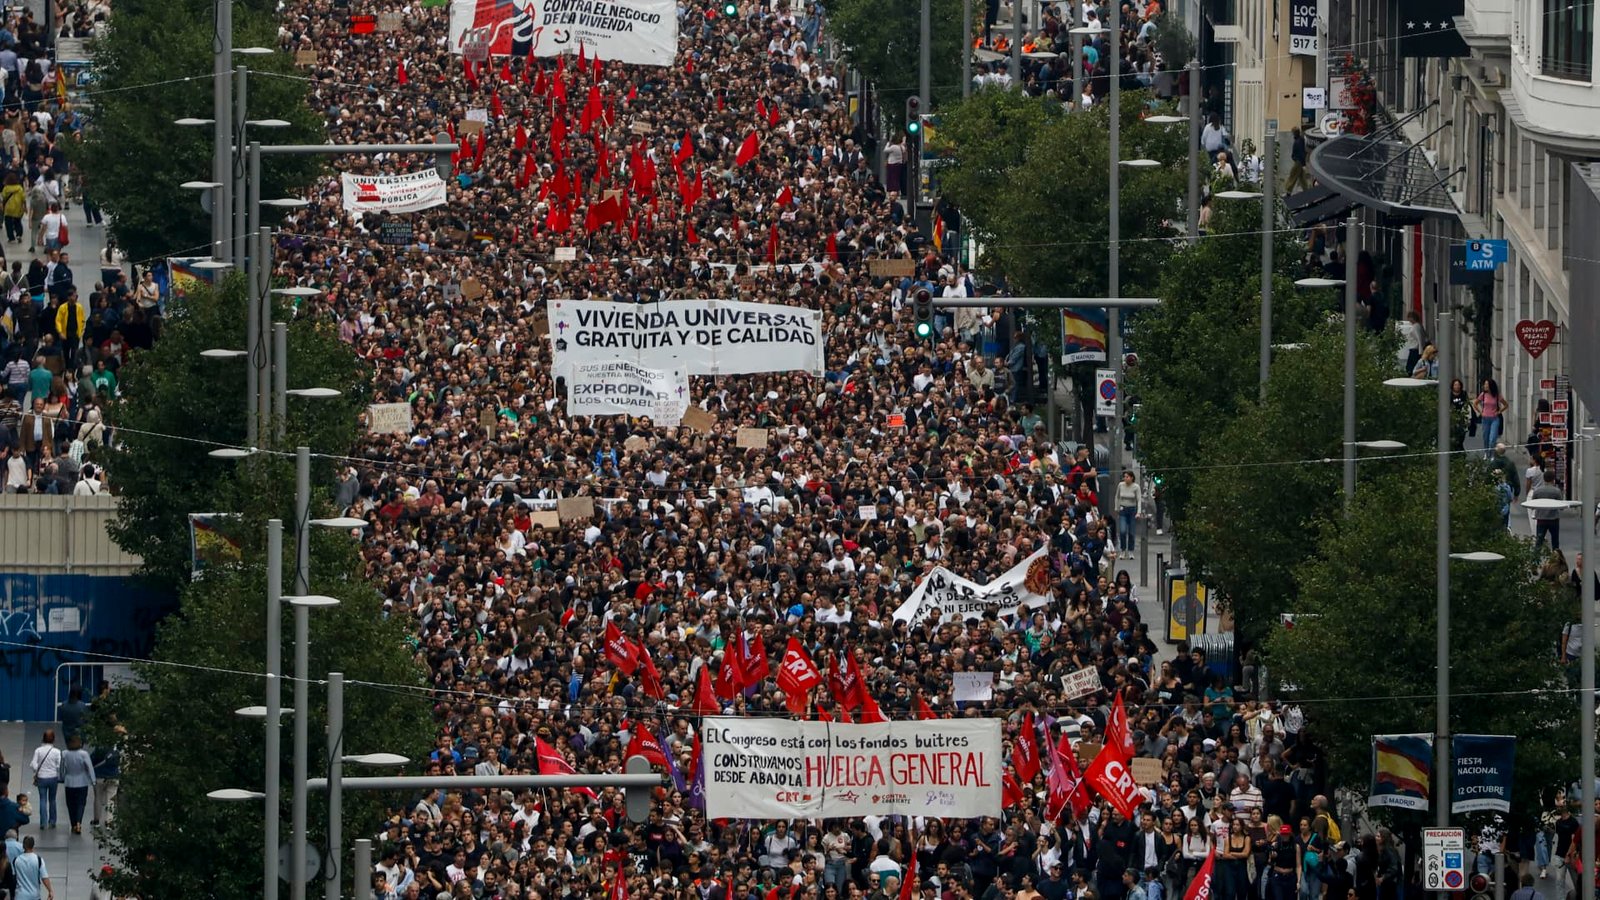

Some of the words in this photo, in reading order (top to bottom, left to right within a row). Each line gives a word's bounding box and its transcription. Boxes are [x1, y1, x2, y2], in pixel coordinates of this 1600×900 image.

[543, 0, 592, 13] CONTRA
[592, 2, 607, 16] EL
[609, 5, 661, 24] NEGOCIO
[1293, 5, 1317, 16] LOC
[543, 13, 561, 26] DE
[560, 11, 577, 25] LA
[578, 13, 633, 32] VIVIENDA
[1293, 17, 1308, 27] EN
[1293, 38, 1309, 49] 917
[353, 170, 436, 185] UNIVERSITARIO
[1481, 243, 1494, 258] S
[1471, 260, 1494, 269] ATM
[576, 309, 680, 330] VIVIENDA
[684, 308, 813, 330] UNIVERSAL
[575, 328, 674, 350] GRATUITA
[676, 330, 691, 345] Y
[695, 329, 722, 346] DE
[727, 327, 816, 346] CALIDAD
[601, 362, 665, 380] BENEFICIOS
[573, 383, 669, 401] EXPROPIAR
[944, 603, 954, 613] NI
[784, 650, 817, 682] CRT
[706, 728, 720, 744] El
[722, 728, 777, 749] Congreso
[781, 735, 805, 749] está
[808, 737, 831, 749] con
[836, 735, 857, 749] los
[859, 734, 908, 749] fondos
[915, 732, 969, 748] buitres
[714, 754, 803, 771] CONSTRUYAMOS
[1457, 757, 1482, 765] FIESTA
[805, 754, 887, 788] HUELGA
[890, 751, 991, 788] GENERAL
[1457, 766, 1499, 776] NACIONAL
[714, 771, 746, 784] DESDE
[749, 772, 787, 786] ABAJO
[789, 774, 803, 787] LA
[1105, 760, 1141, 803] CRT
[776, 792, 799, 802] CRT
[1457, 787, 1465, 796] 12
[1466, 785, 1505, 797] OCTUBRE
[1388, 797, 1416, 807] MADRID
